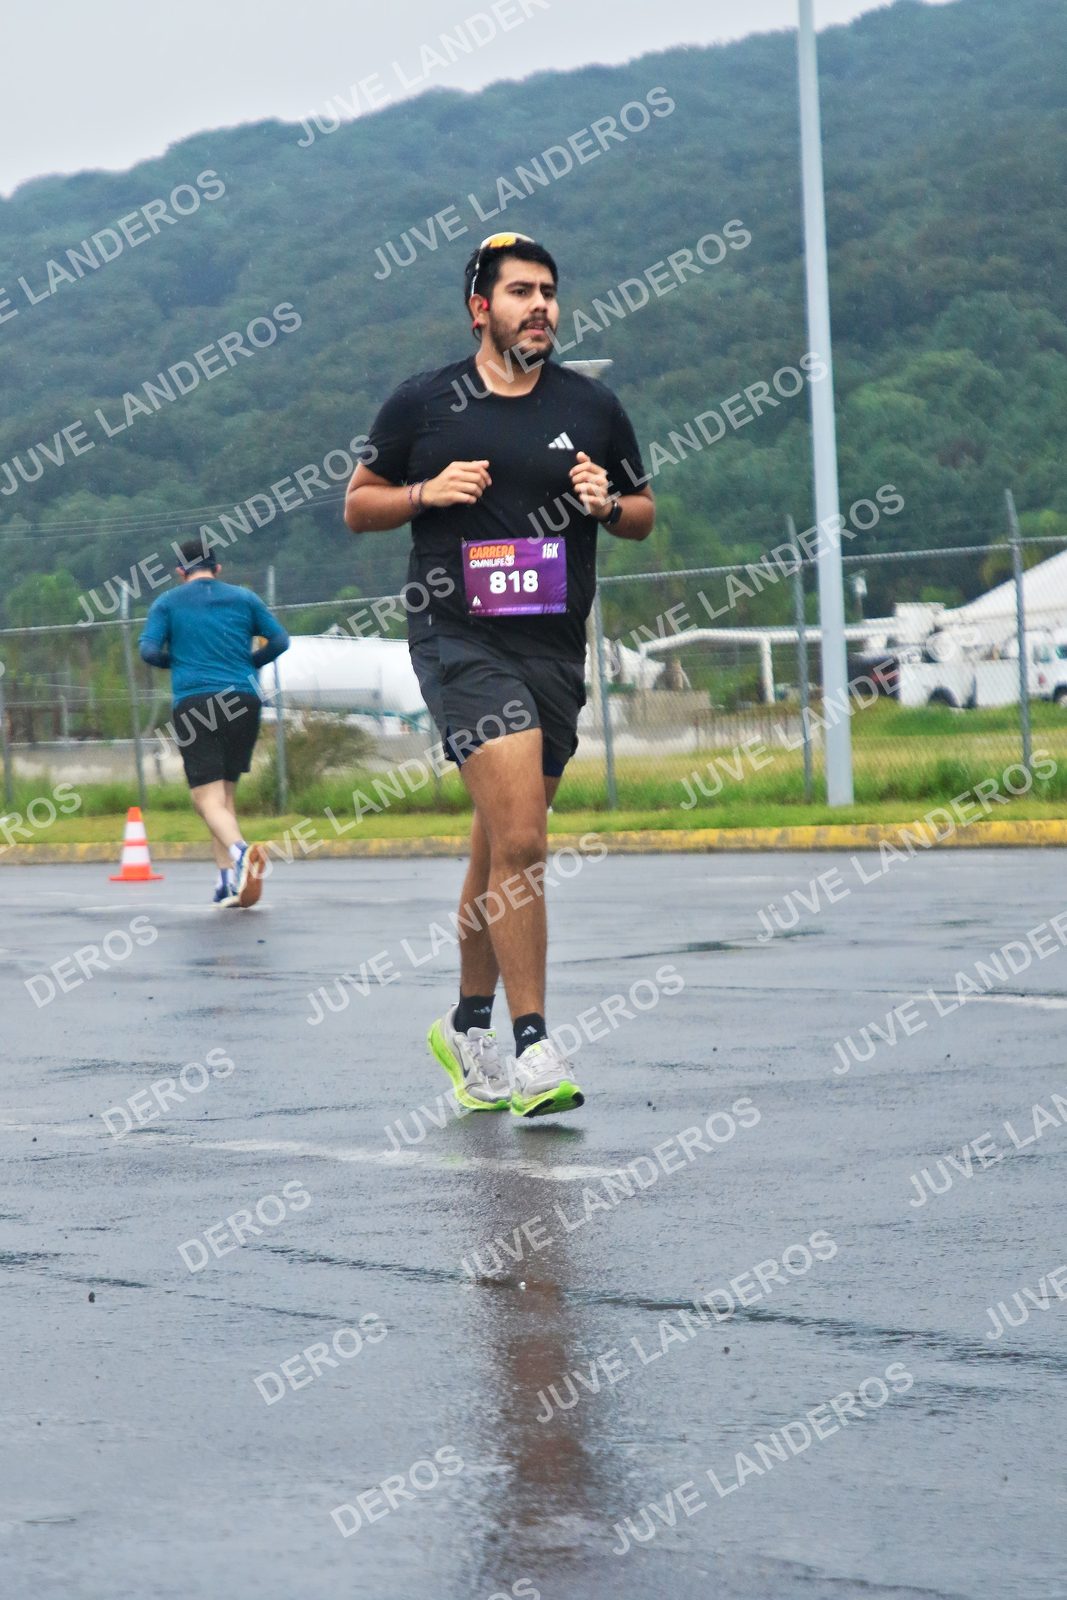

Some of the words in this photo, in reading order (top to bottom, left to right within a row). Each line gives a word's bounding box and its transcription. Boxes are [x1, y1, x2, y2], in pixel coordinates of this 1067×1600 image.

[469, 544, 515, 560] CARRERA
[469, 558, 505, 569] OMNILIFE
[489, 570, 539, 594] 818
